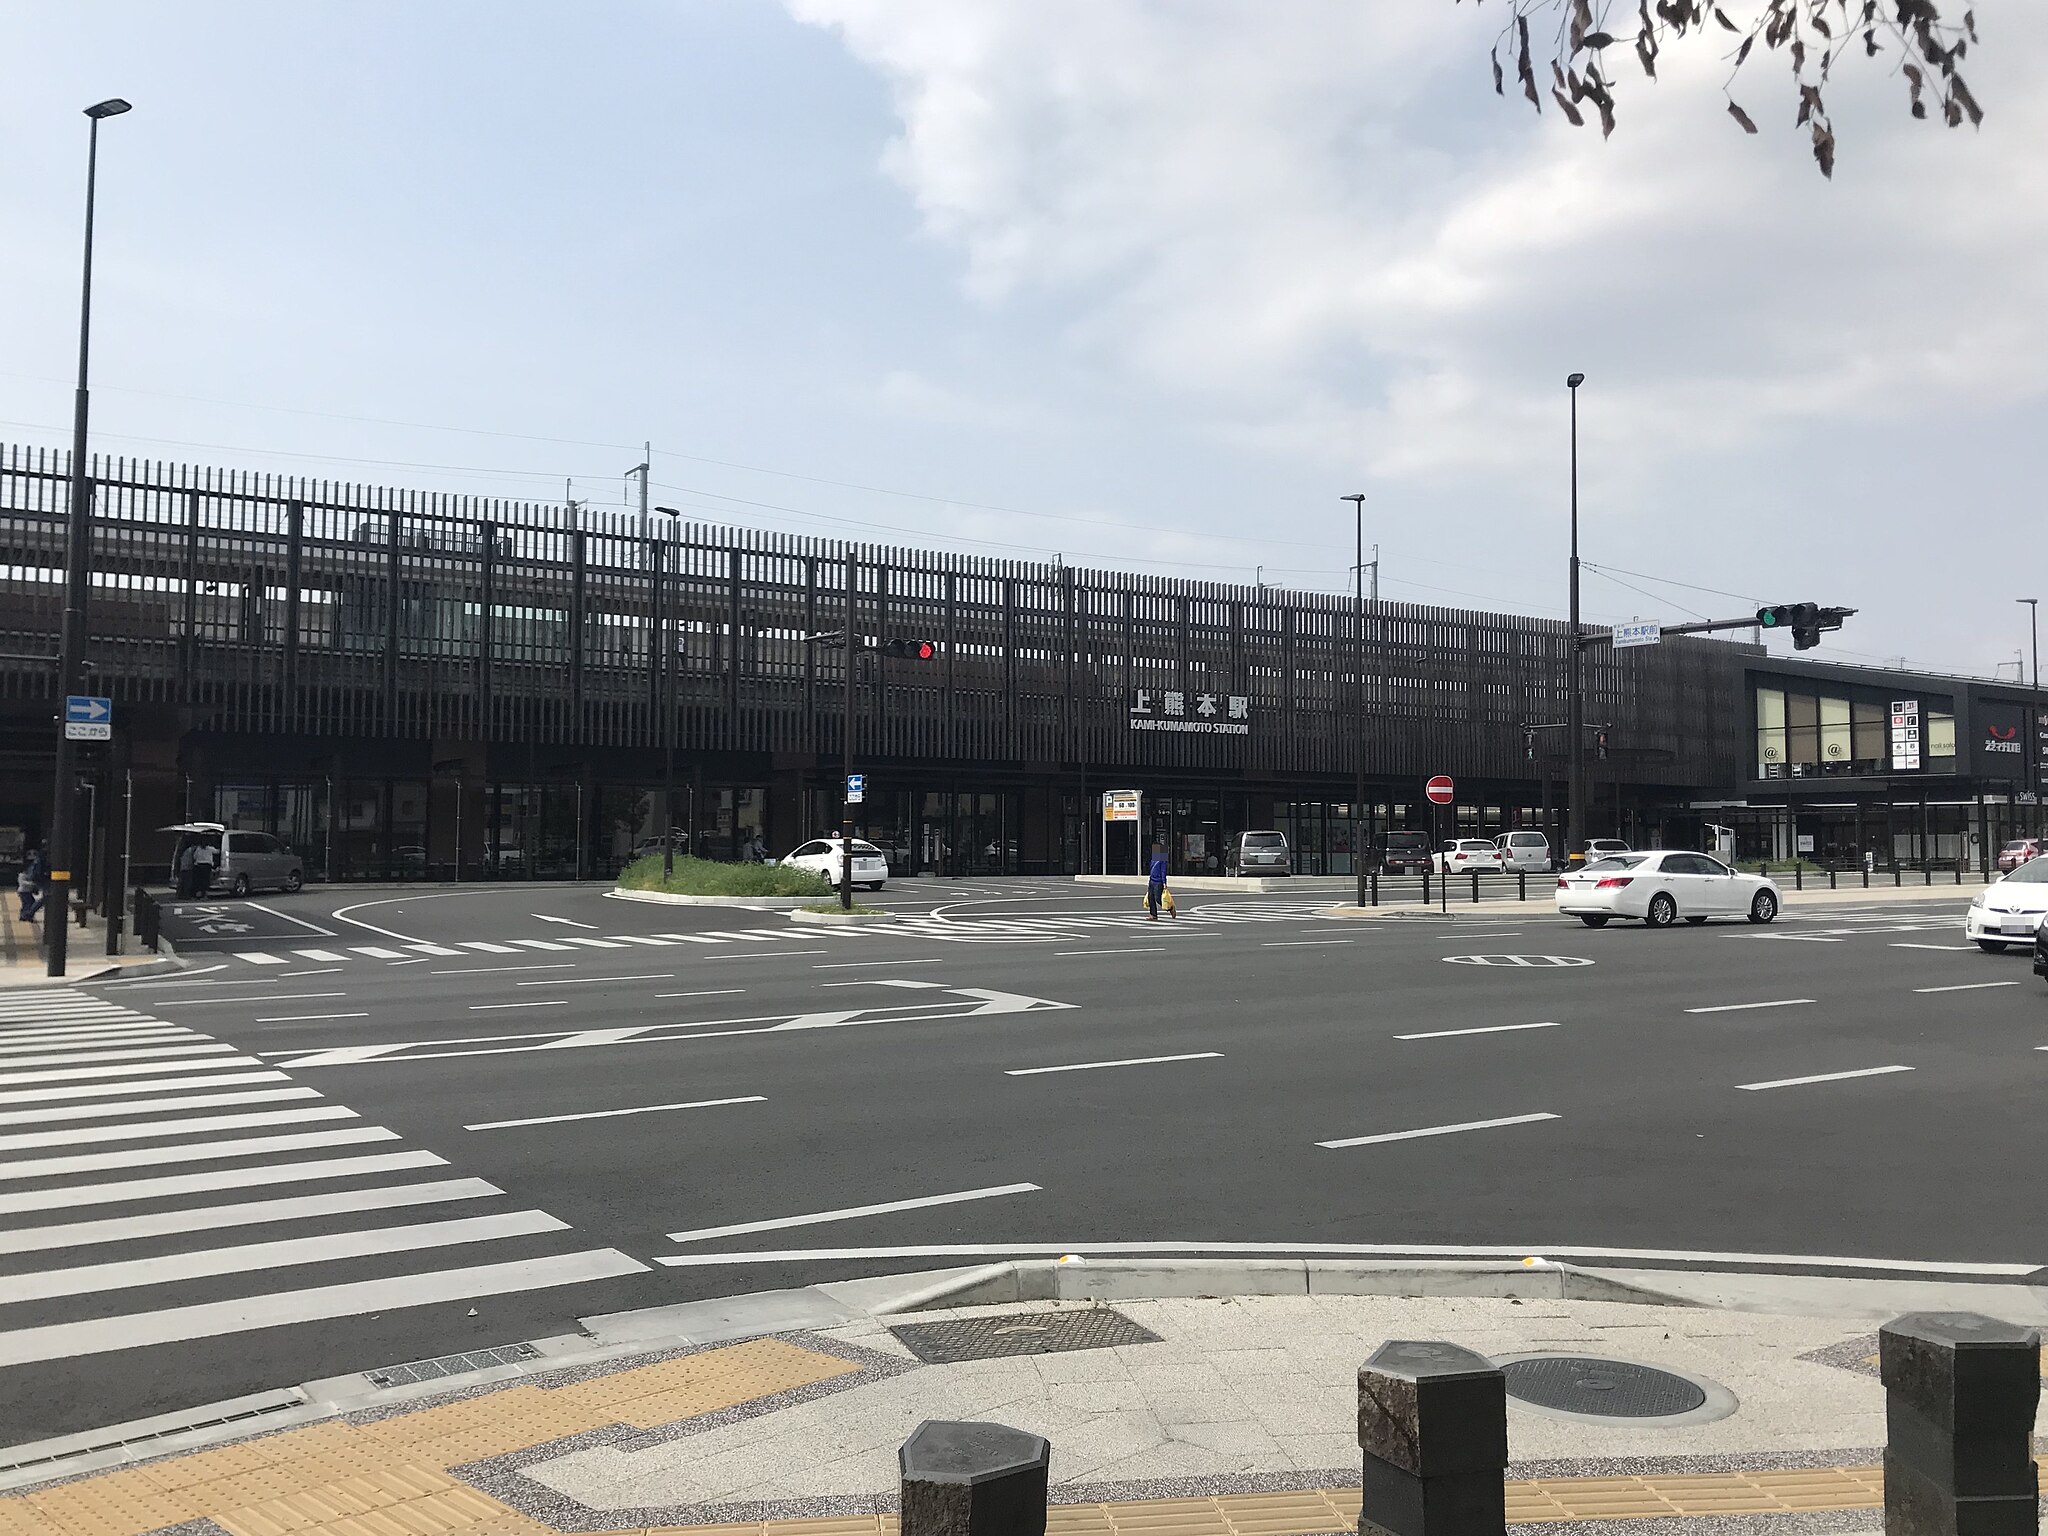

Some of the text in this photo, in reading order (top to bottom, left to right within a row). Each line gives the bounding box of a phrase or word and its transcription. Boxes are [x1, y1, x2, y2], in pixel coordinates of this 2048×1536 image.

[1615, 625, 1658, 638] 上熊本駅前
[1130, 689, 1248, 719] 上熊本駅
[67, 726, 108, 737] ここから
[1130, 718, 1248, 735] KAMI-KUMAMOTO STATION
